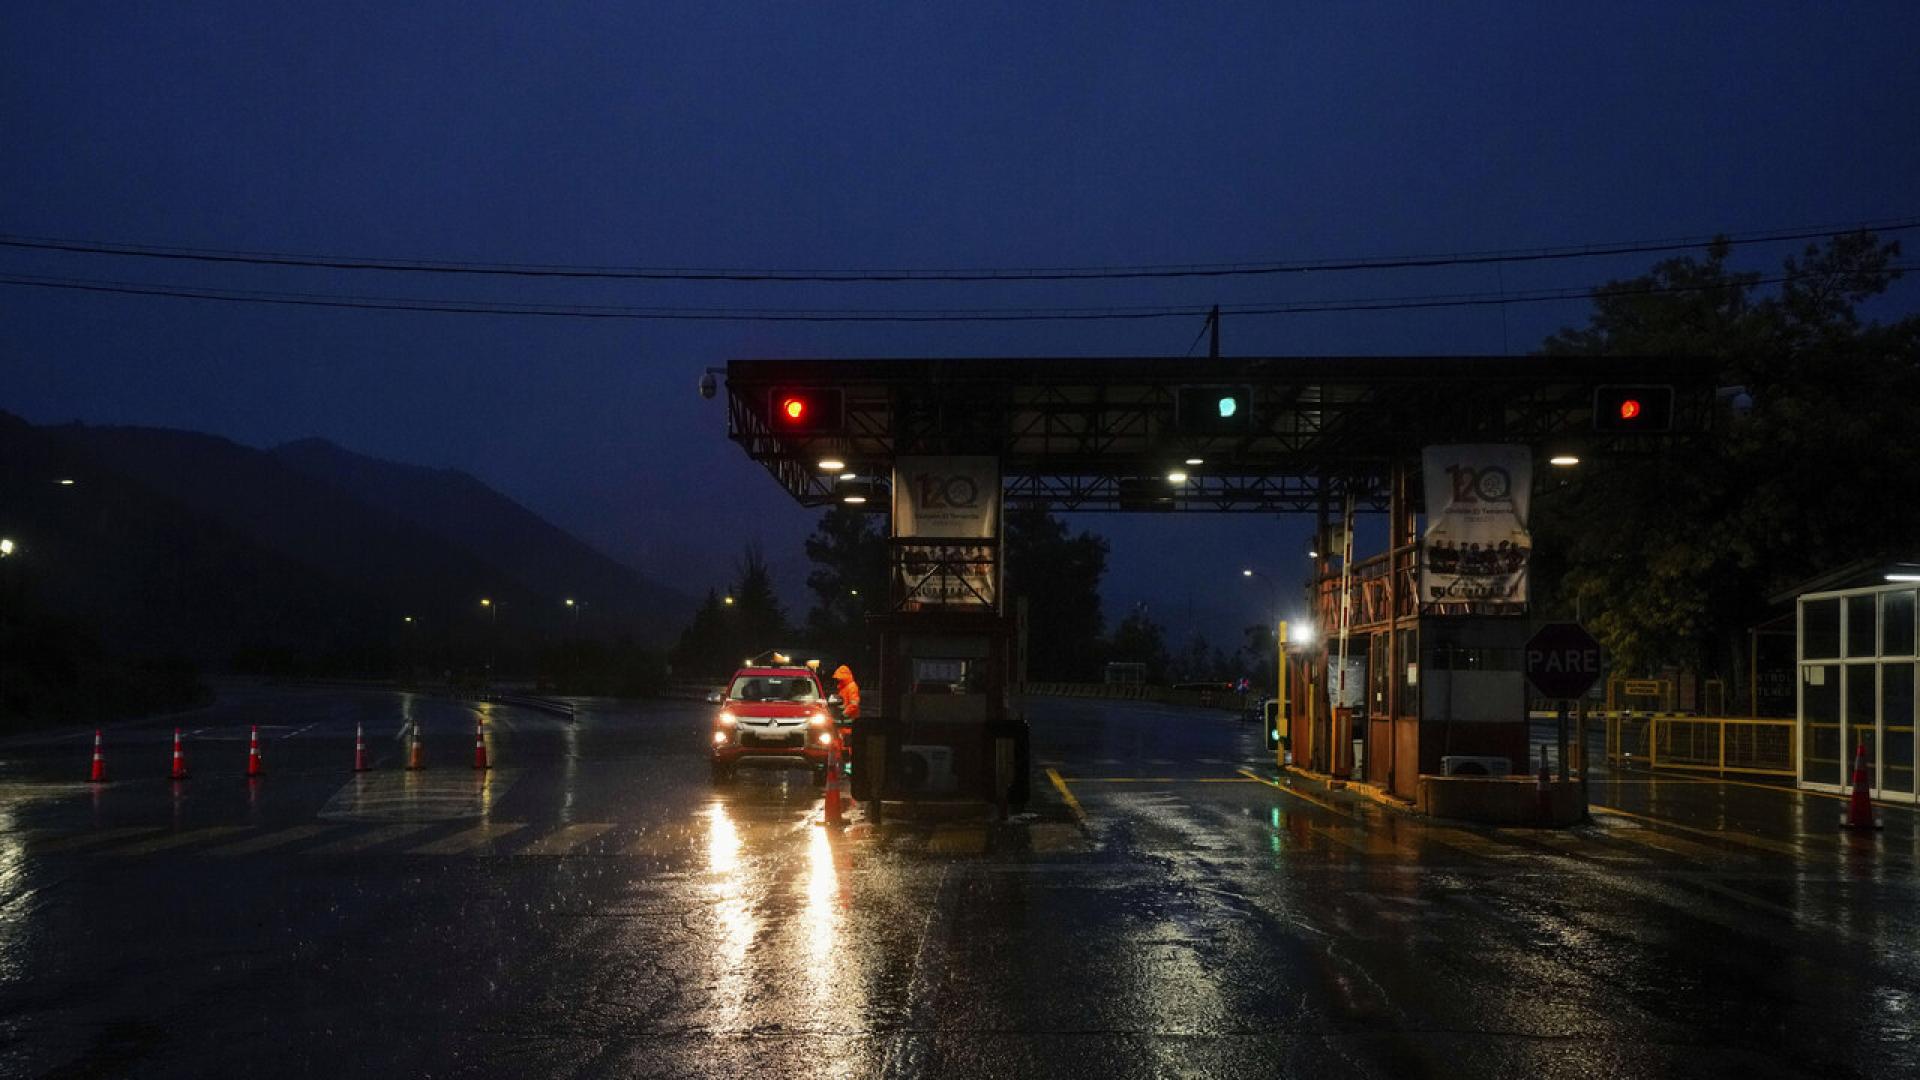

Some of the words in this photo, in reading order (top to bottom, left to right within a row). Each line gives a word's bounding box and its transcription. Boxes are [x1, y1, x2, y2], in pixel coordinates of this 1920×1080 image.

[915, 473, 978, 507] 120
[1445, 464, 1512, 501] 120
[1527, 649, 1597, 672] PARE
